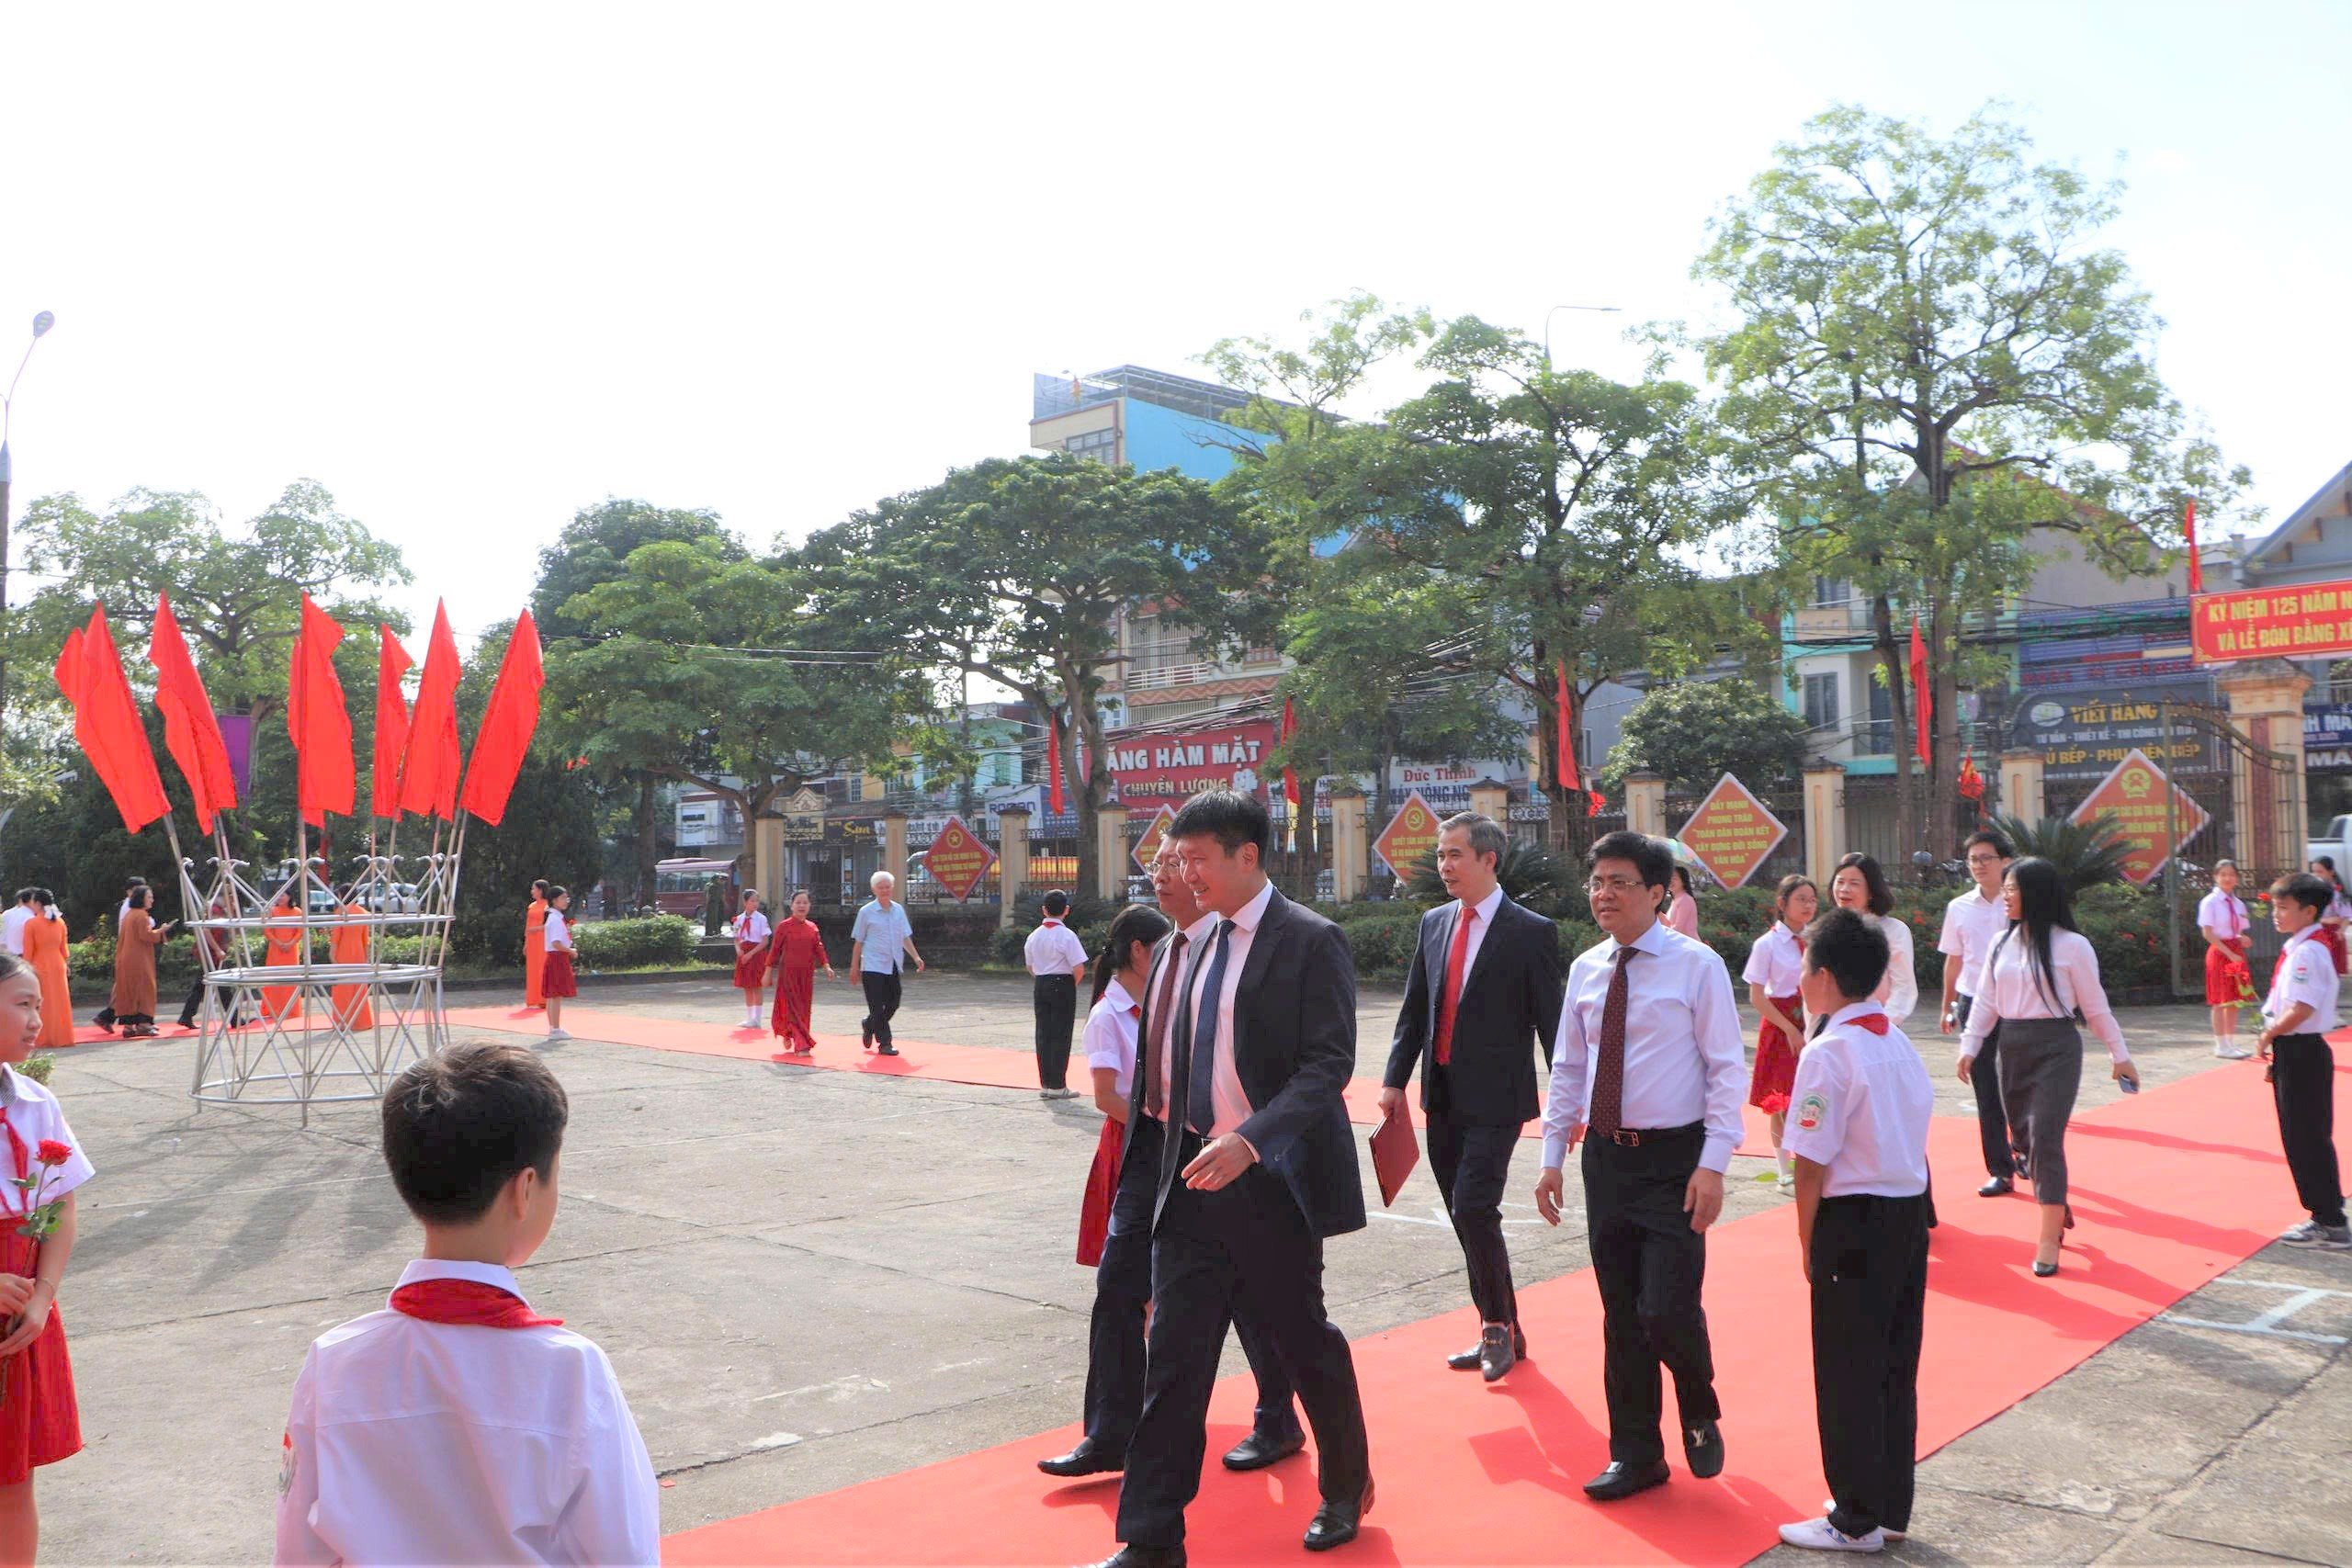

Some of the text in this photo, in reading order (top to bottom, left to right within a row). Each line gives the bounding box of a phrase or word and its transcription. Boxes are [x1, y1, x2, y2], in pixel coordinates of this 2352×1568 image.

[2231, 595, 2267, 622] NIỆM
[2272, 596, 2298, 615] 125
[2301, 589, 2337, 613] NĂM
[2218, 628, 2235, 651] VÀ
[2259, 625, 2290, 648] ĐÓN
[1106, 734, 1261, 772] ĂNG HÀM MẶT
[1403, 768, 1430, 782] Đức
